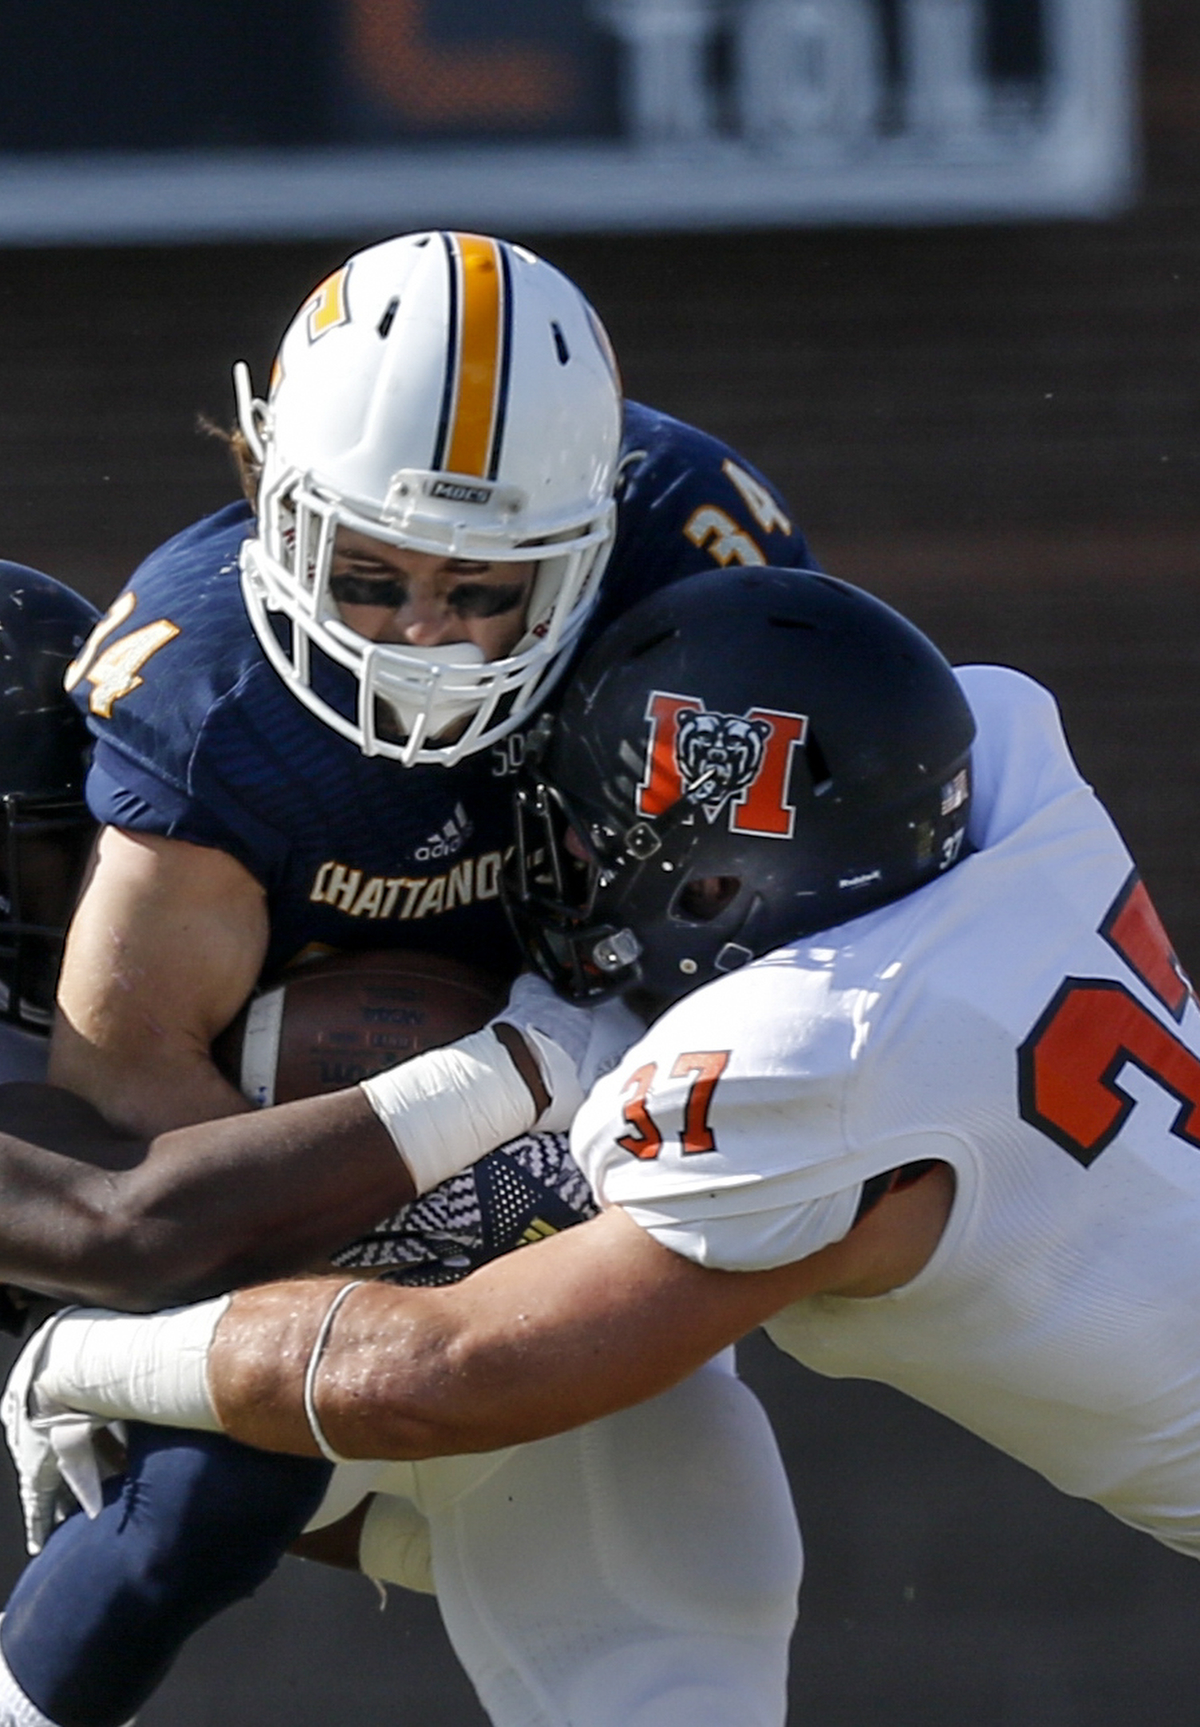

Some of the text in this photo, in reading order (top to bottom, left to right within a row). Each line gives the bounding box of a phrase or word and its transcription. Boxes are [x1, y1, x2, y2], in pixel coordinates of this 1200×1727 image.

[683, 457, 792, 568] 34
[309, 846, 515, 919] CHATTANO
[614, 1048, 732, 1162] 37
